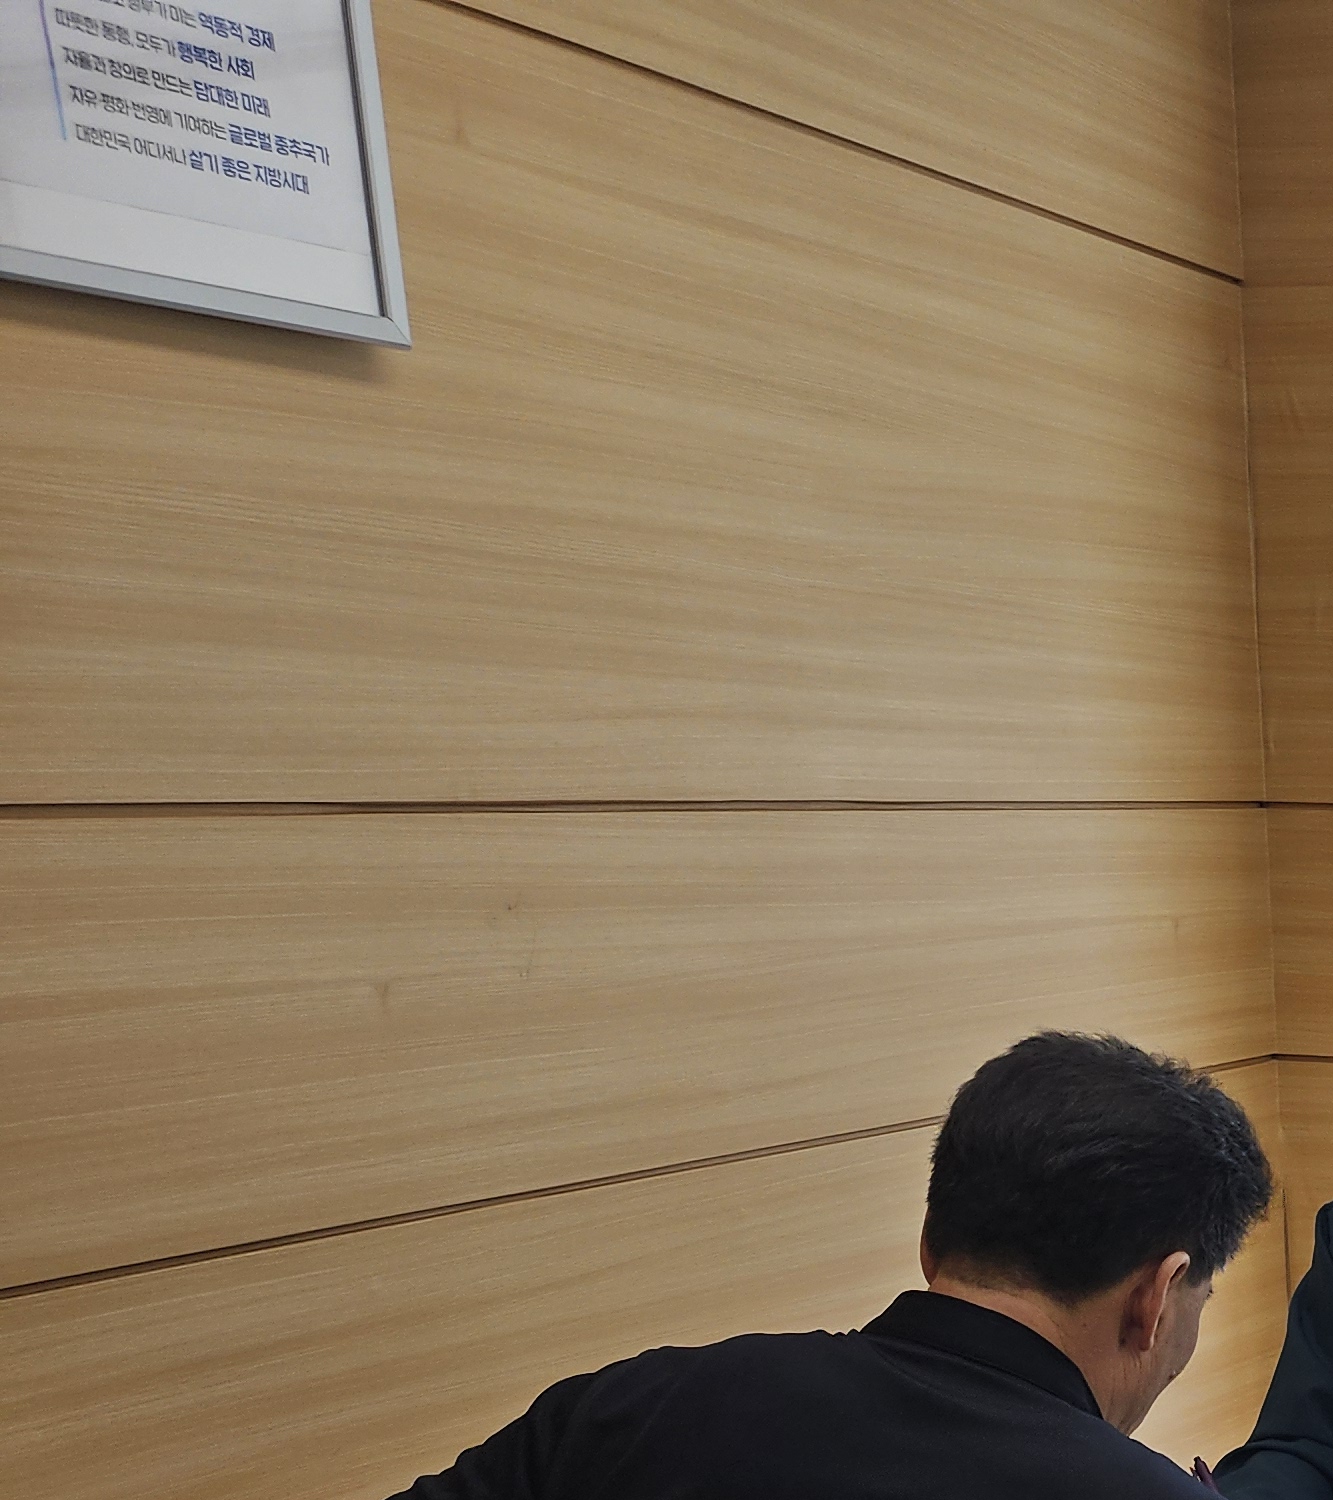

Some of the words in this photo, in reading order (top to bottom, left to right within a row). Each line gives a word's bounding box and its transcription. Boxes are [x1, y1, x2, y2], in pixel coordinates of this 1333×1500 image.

[135, 30, 176, 57] 모두가
[177, 41, 223, 72] 행복한
[227, 55, 255, 80] 사회
[170, 4, 197, 28] 미는
[198, 12, 244, 42] 역동적
[246, 25, 275, 51] 경제
[62, 46, 106, 75] 자율과
[109, 58, 151, 86] 창의로
[151, 70, 193, 97] 만드는
[194, 80, 240, 110] 담대한
[241, 92, 271, 118] 미래
[69, 85, 97, 108] 자유
[101, 92, 129, 116] 평화
[132, 101, 173, 127] 번영에
[174, 111, 227, 140] 기여하는
[229, 123, 273, 152] 글로벌
[275, 134, 330, 166] 중추국가
[75, 123, 132, 154] 대한민국
[135, 136, 187, 166] 어디서나
[189, 150, 219, 174] 살기
[221, 156, 251, 181] 좋은
[253, 163, 309, 195] 지방시대
